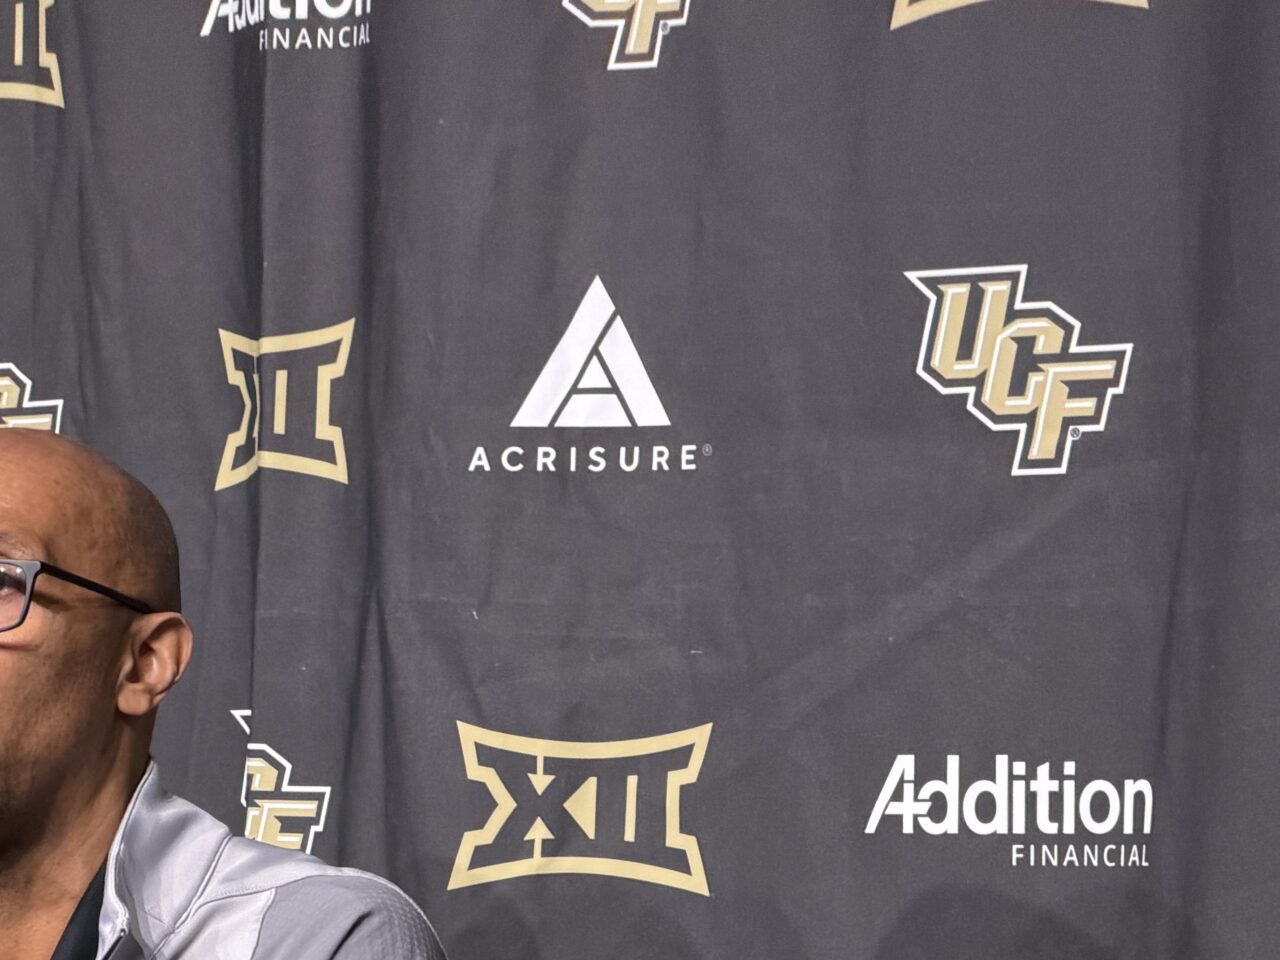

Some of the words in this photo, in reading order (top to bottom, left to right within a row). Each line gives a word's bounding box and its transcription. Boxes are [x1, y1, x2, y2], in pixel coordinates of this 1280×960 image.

[258, 22, 371, 51] FINANCIAL
[903, 263, 1134, 477] UCF
[468, 444, 699, 472] ACRISURE
[446, 719, 714, 897] XII
[864, 754, 1153, 836] Addition
[1011, 844, 1149, 867] FINANCIAL
